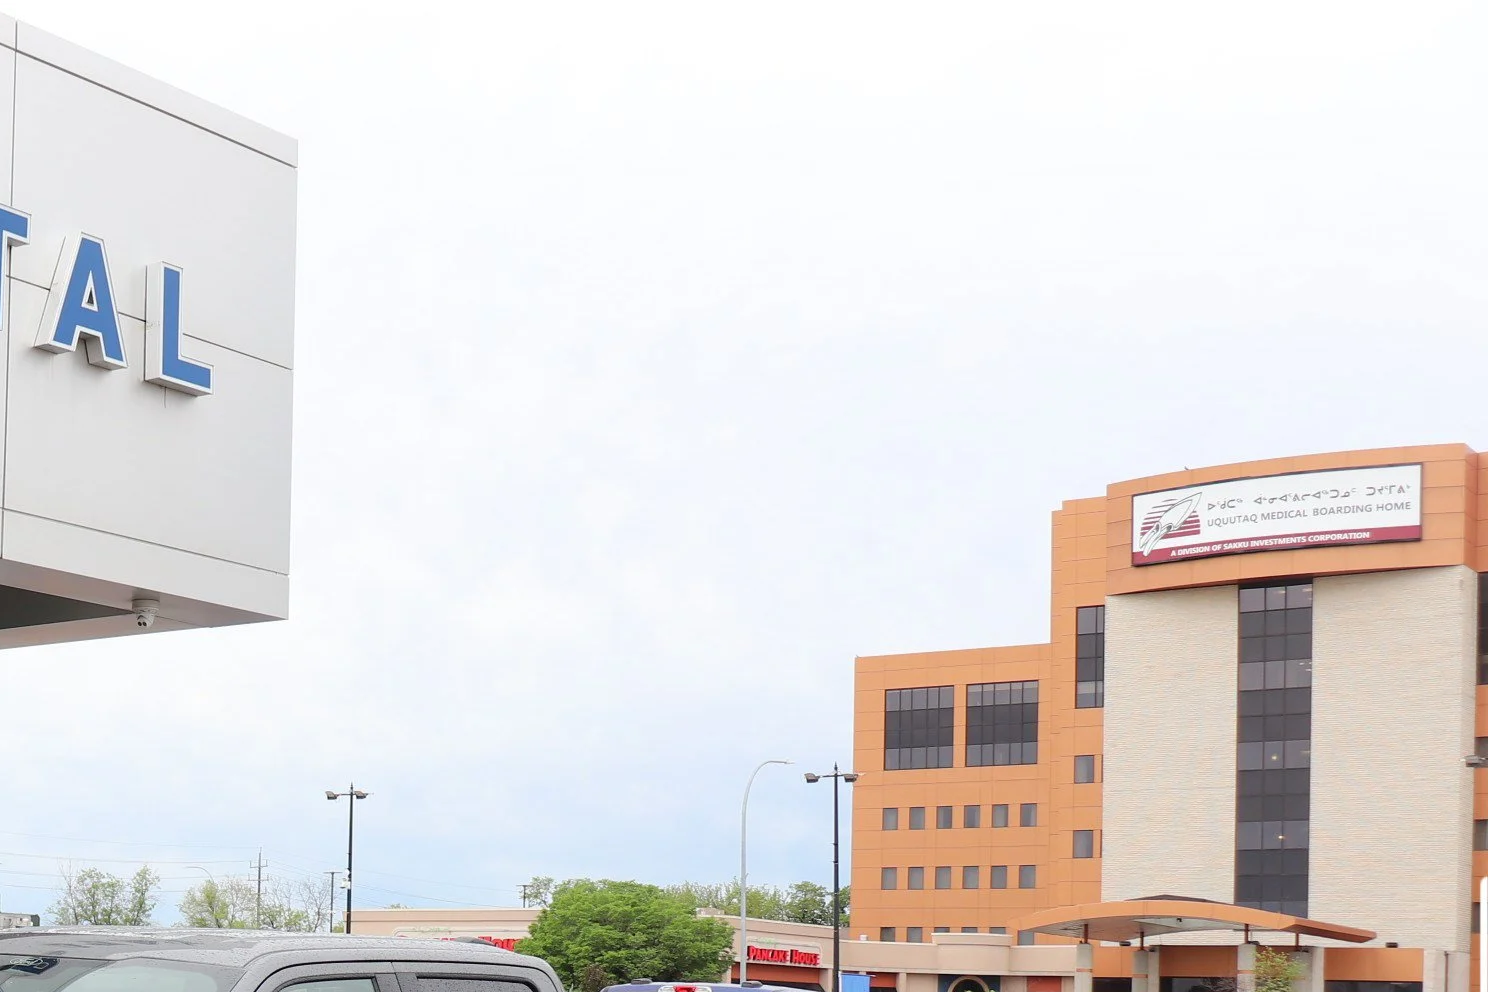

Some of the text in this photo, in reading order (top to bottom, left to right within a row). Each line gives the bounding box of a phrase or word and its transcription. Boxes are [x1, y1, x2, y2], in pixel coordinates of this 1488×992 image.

[1207, 502, 1411, 527] UQUUTAQ MEDICAL BOARDING HOME
[1177, 545, 1210, 556] DIVISION
[1211, 543, 1222, 552] OF
[1223, 540, 1249, 550] SAKKU
[1250, 535, 1306, 547] INVESTMENTS
[1308, 531, 1370, 542] CORPORATION
[747, 945, 820, 966] PANCAKE HOUSE
